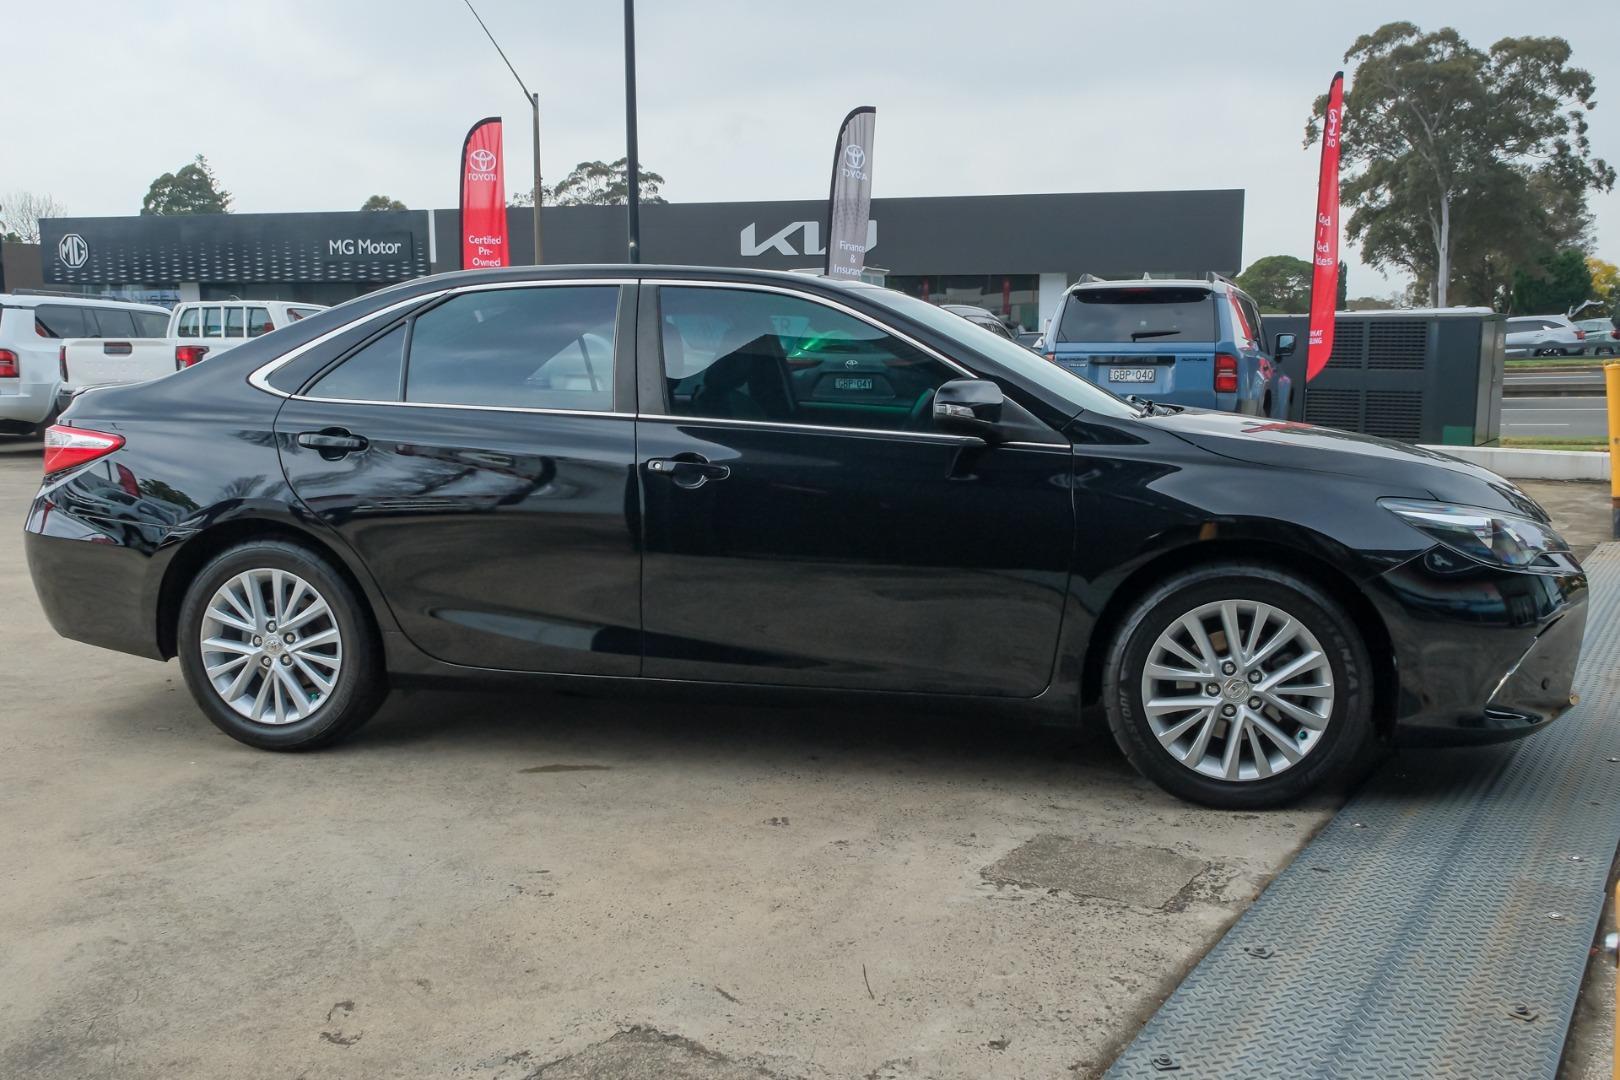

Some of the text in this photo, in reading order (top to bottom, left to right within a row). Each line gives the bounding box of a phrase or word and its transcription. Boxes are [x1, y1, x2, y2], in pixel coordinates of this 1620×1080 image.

[842, 168, 868, 181] TOYOA
[60, 235, 87, 266] MG
[329, 239, 402, 255] MG Motor
[850, 254, 856, 263] &
[1113, 370, 1132, 380] GBP
